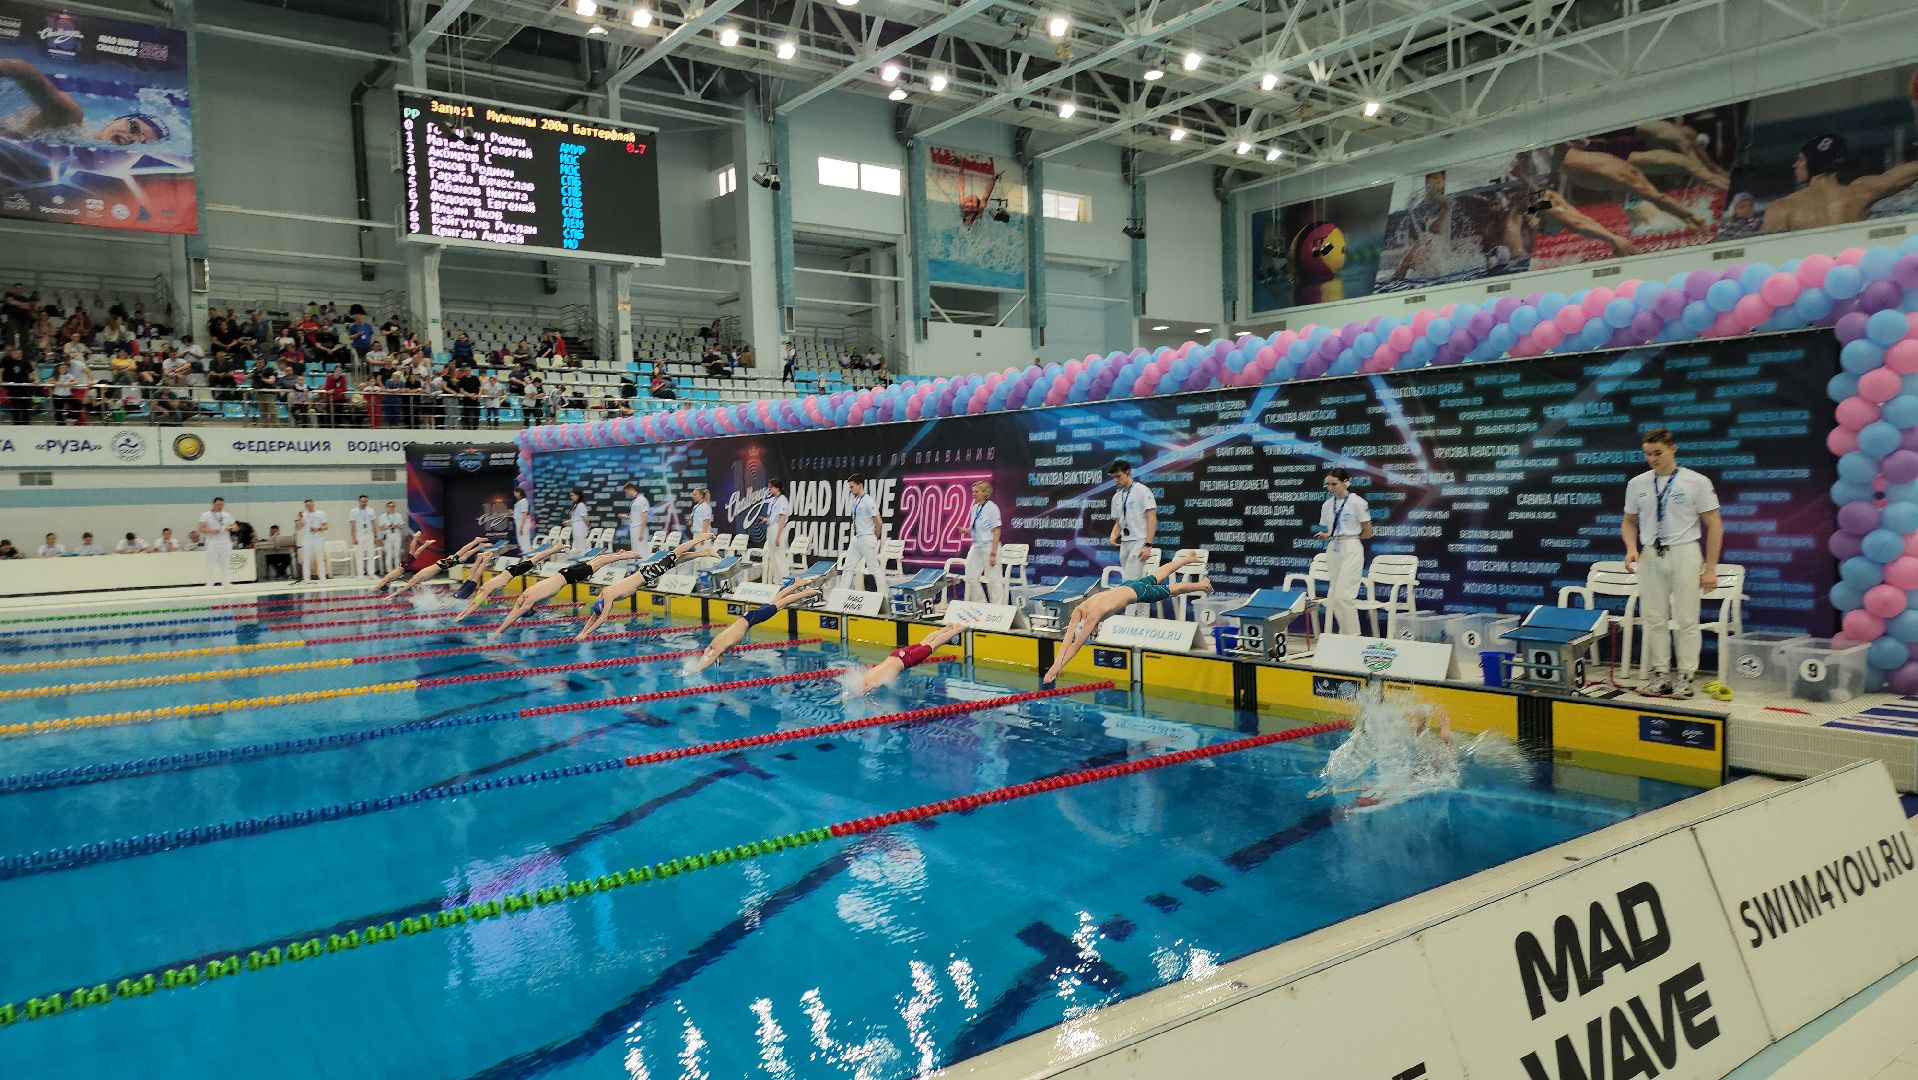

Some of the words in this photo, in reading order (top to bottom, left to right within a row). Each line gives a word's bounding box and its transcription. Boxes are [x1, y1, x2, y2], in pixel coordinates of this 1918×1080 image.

[486, 109, 537, 128] Мужчины
[573, 124, 636, 143] Баттерфляй
[490, 132, 526, 147] Роман
[484, 142, 533, 159] Георгий
[428, 156, 467, 171] Боков
[471, 162, 515, 178] Родион
[429, 167, 473, 184] Гараба
[479, 175, 535, 192] Вячеслав
[430, 179, 481, 196] Лобанов
[486, 186, 529, 201] Никита
[430, 202, 469, 217] Ильин
[474, 207, 503, 221] Яков
[487, 198, 536, 213] Евгений
[431, 213, 490, 229] Байгутов
[495, 220, 538, 235] Руслан
[482, 230, 525, 244] Андрей
[35, 440, 102, 454] «РУЗА»
[232, 440, 332, 454] ФЕДЕРАЦИЯ
[915, 446, 996, 464] ПЛАВАНИЮ
[1230, 478, 1270, 491] ЕЛИЗАВЕТА
[788, 480, 832, 517] MAD
[835, 478, 897, 517] WVE
[1553, 492, 1602, 505] АНГЕЛИНА
[783, 520, 893, 558] CHALLEE
[924, 600, 933, 615] 6
[1204, 611, 1211, 622] 7
[1112, 625, 1182, 641] SWIM4YOU.RU
[1275, 632, 1287, 658] 8
[1575, 659, 1585, 689] 9
[1807, 663, 1818, 678] 9
[1739, 830, 1914, 949] SWIM4YOU.RU
[1514, 881, 1672, 1021] MAD
[1519, 961, 1721, 1080] WAVE
